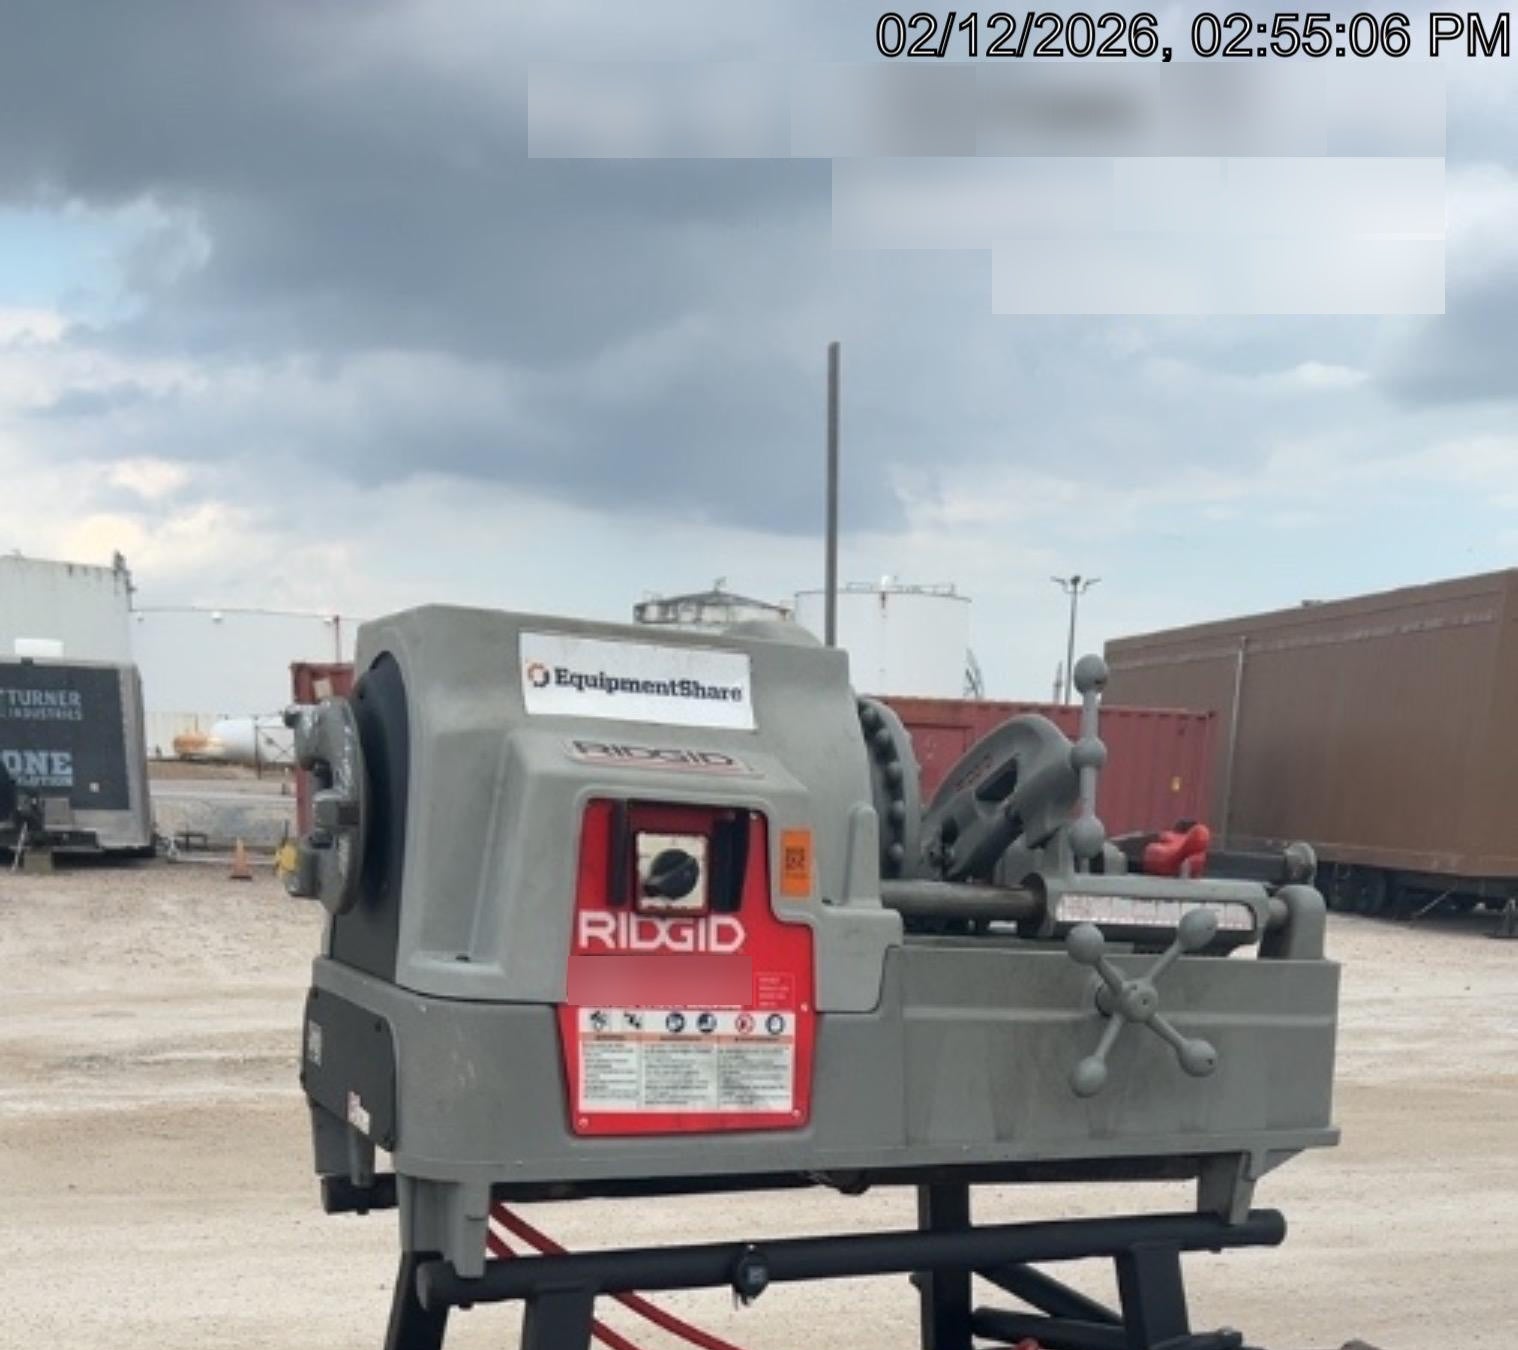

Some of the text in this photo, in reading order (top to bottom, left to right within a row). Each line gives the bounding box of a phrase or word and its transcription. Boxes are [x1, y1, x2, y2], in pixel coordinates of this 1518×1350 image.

[8, 688, 82, 706] TURNER
[554, 667, 743, 702] EquipmentShare
[578, 910, 746, 953] RIDGID
